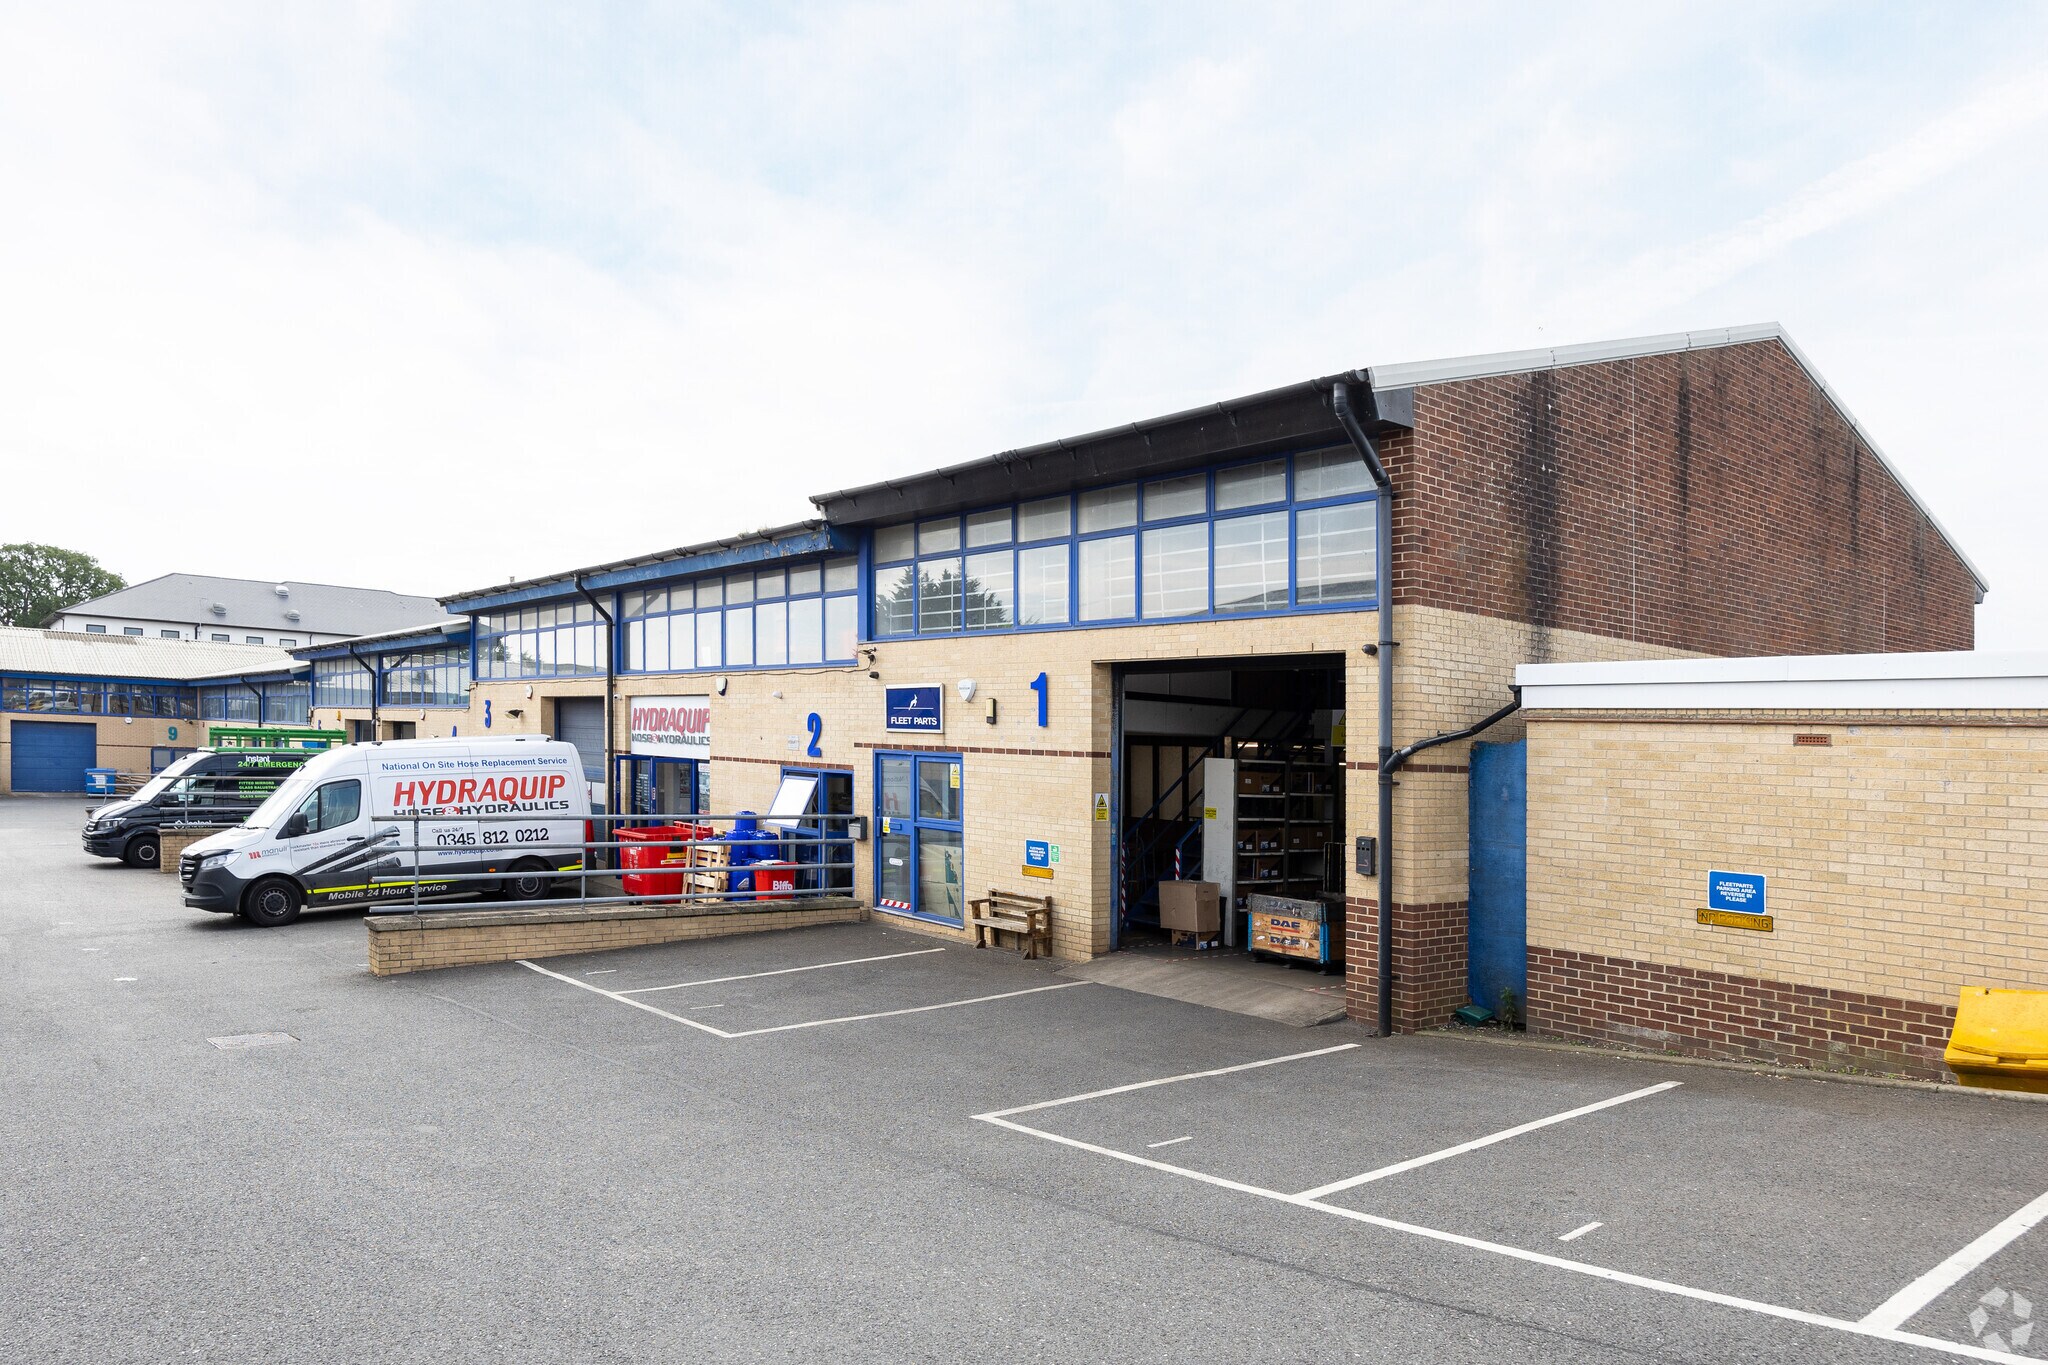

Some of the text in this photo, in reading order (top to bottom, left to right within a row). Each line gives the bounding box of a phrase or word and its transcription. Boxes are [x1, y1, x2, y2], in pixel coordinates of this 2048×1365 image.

[1030, 672, 1048, 727] 1
[484, 700, 492, 729] 3
[631, 707, 710, 736] HYDRAQUIP
[890, 716, 938, 726] FLEET PARTS
[168, 726, 178, 741] 9
[807, 712, 822, 757] 2
[382, 757, 567, 771] National On Site Hose Replacement Service
[394, 775, 565, 807] HYDRAQUIP
[460, 801, 569, 815] HYDRAULICS
[437, 828, 549, 845] 0345 812 0212
[328, 884, 447, 900] Mobile 24 Hour Service
[1719, 881, 1754, 889] FLEETPARTS
